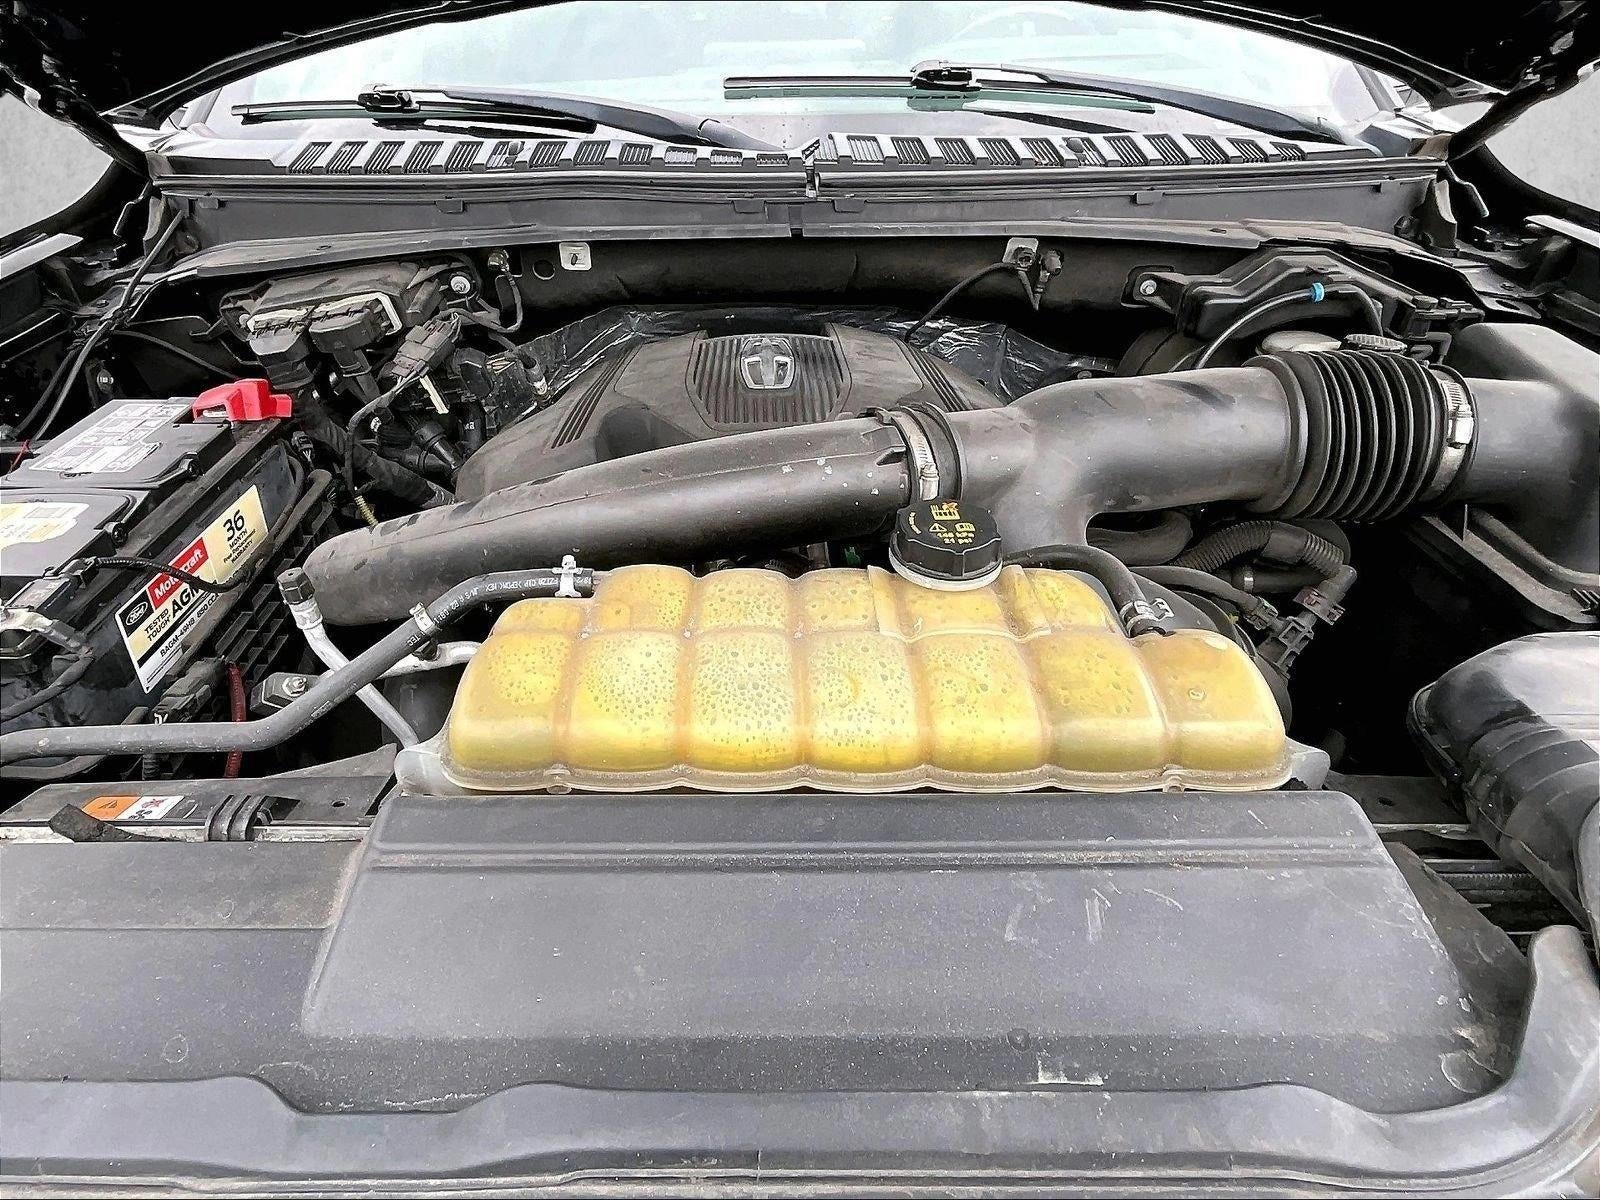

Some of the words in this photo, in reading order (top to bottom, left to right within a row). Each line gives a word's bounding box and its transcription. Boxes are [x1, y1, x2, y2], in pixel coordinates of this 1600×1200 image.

[223, 509, 245, 541] 36
[229, 528, 248, 549] MONTH
[144, 608, 169, 634] TESTED
